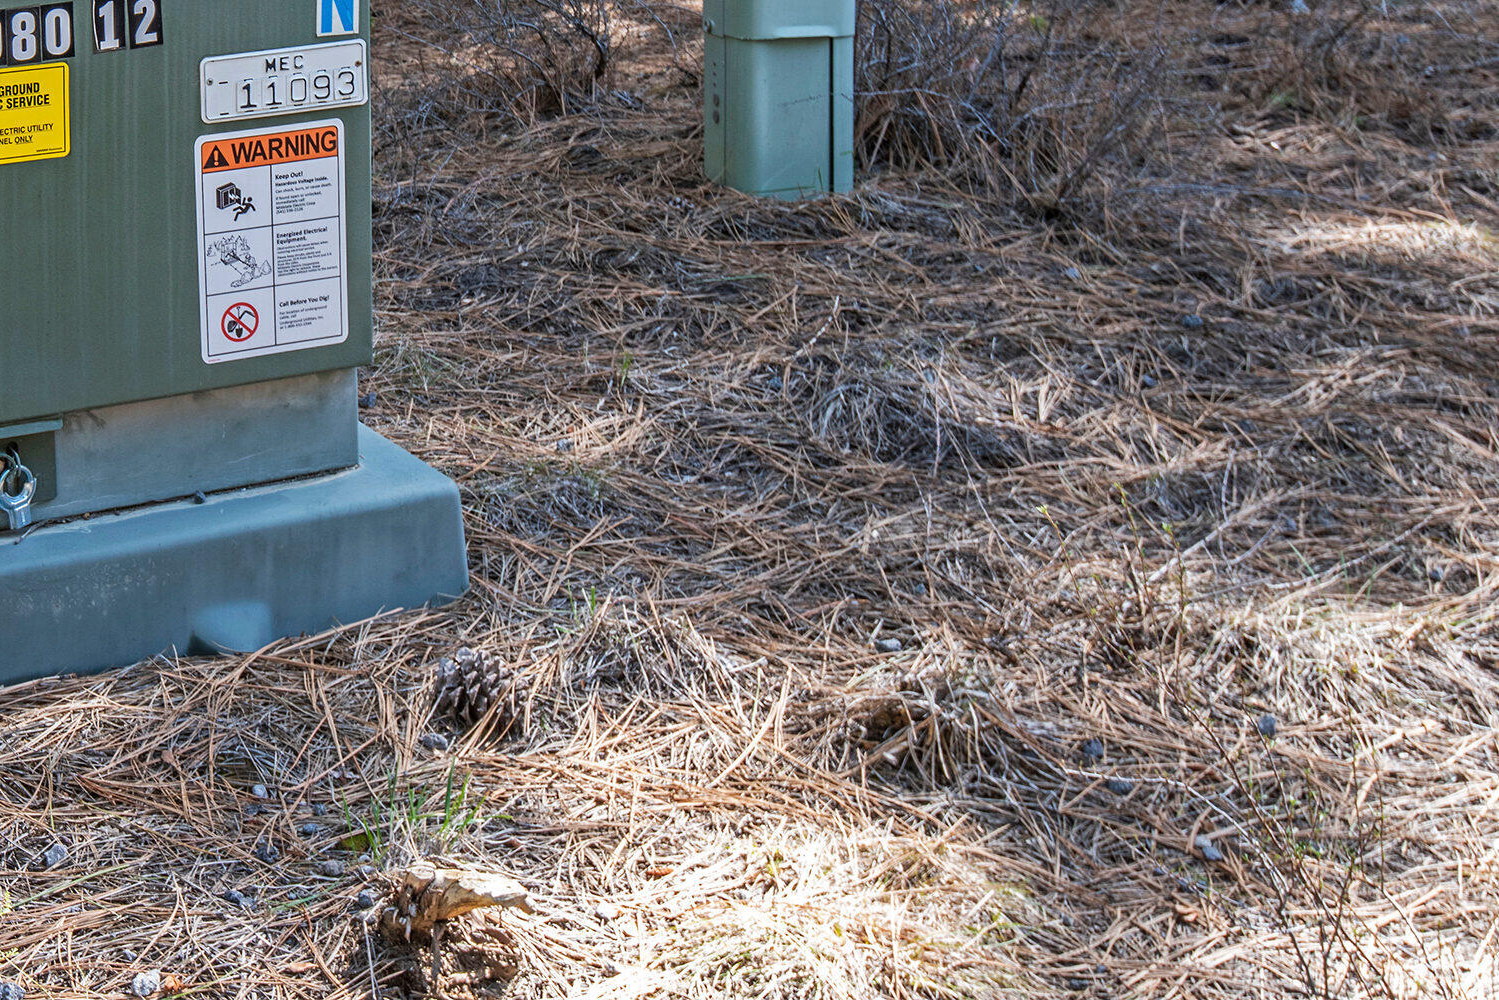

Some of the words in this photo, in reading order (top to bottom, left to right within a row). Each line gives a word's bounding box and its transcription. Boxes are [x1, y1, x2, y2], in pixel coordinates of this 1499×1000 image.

[265, 56, 304, 72] MEC
[240, 72, 355, 109] 11093
[6, 94, 50, 109] SERVICE
[27, 123, 54, 132] UTILITY
[15, 135, 33, 144] ONLY
[231, 131, 337, 164] WARNING
[290, 298, 307, 306] Before
